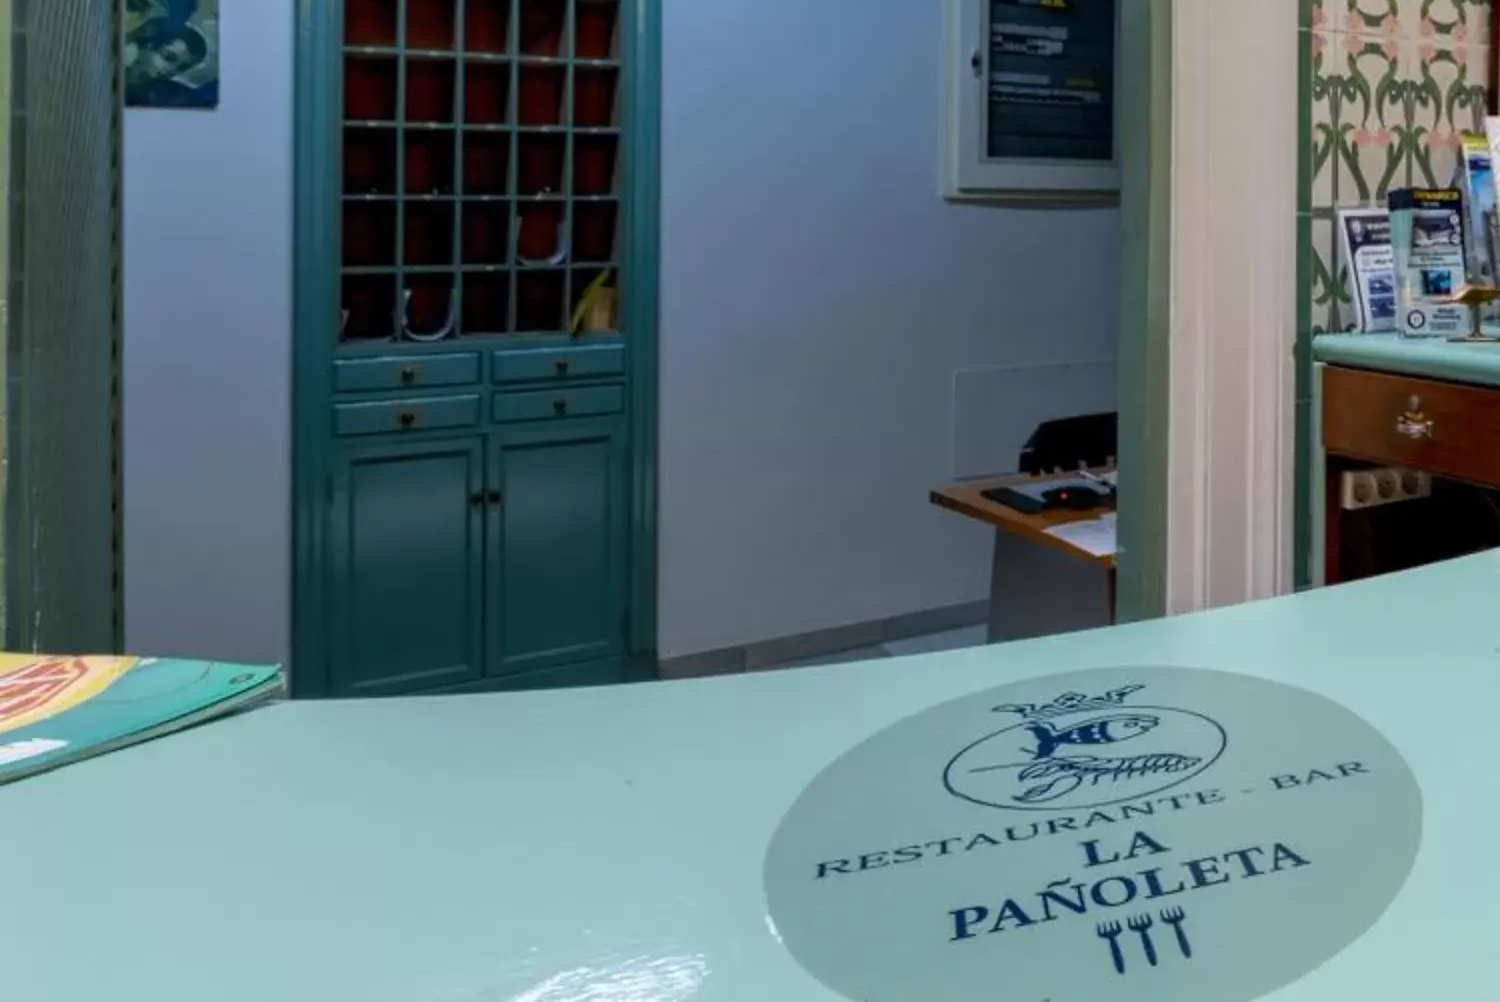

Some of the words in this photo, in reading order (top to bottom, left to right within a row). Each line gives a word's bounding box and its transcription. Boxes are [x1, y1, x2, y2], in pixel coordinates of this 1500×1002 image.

[813, 790, 1227, 880] RESTAURANTE
[1269, 760, 1371, 791] BAR
[1077, 830, 1172, 868] LA
[946, 842, 1312, 942] PAÑOLETA
